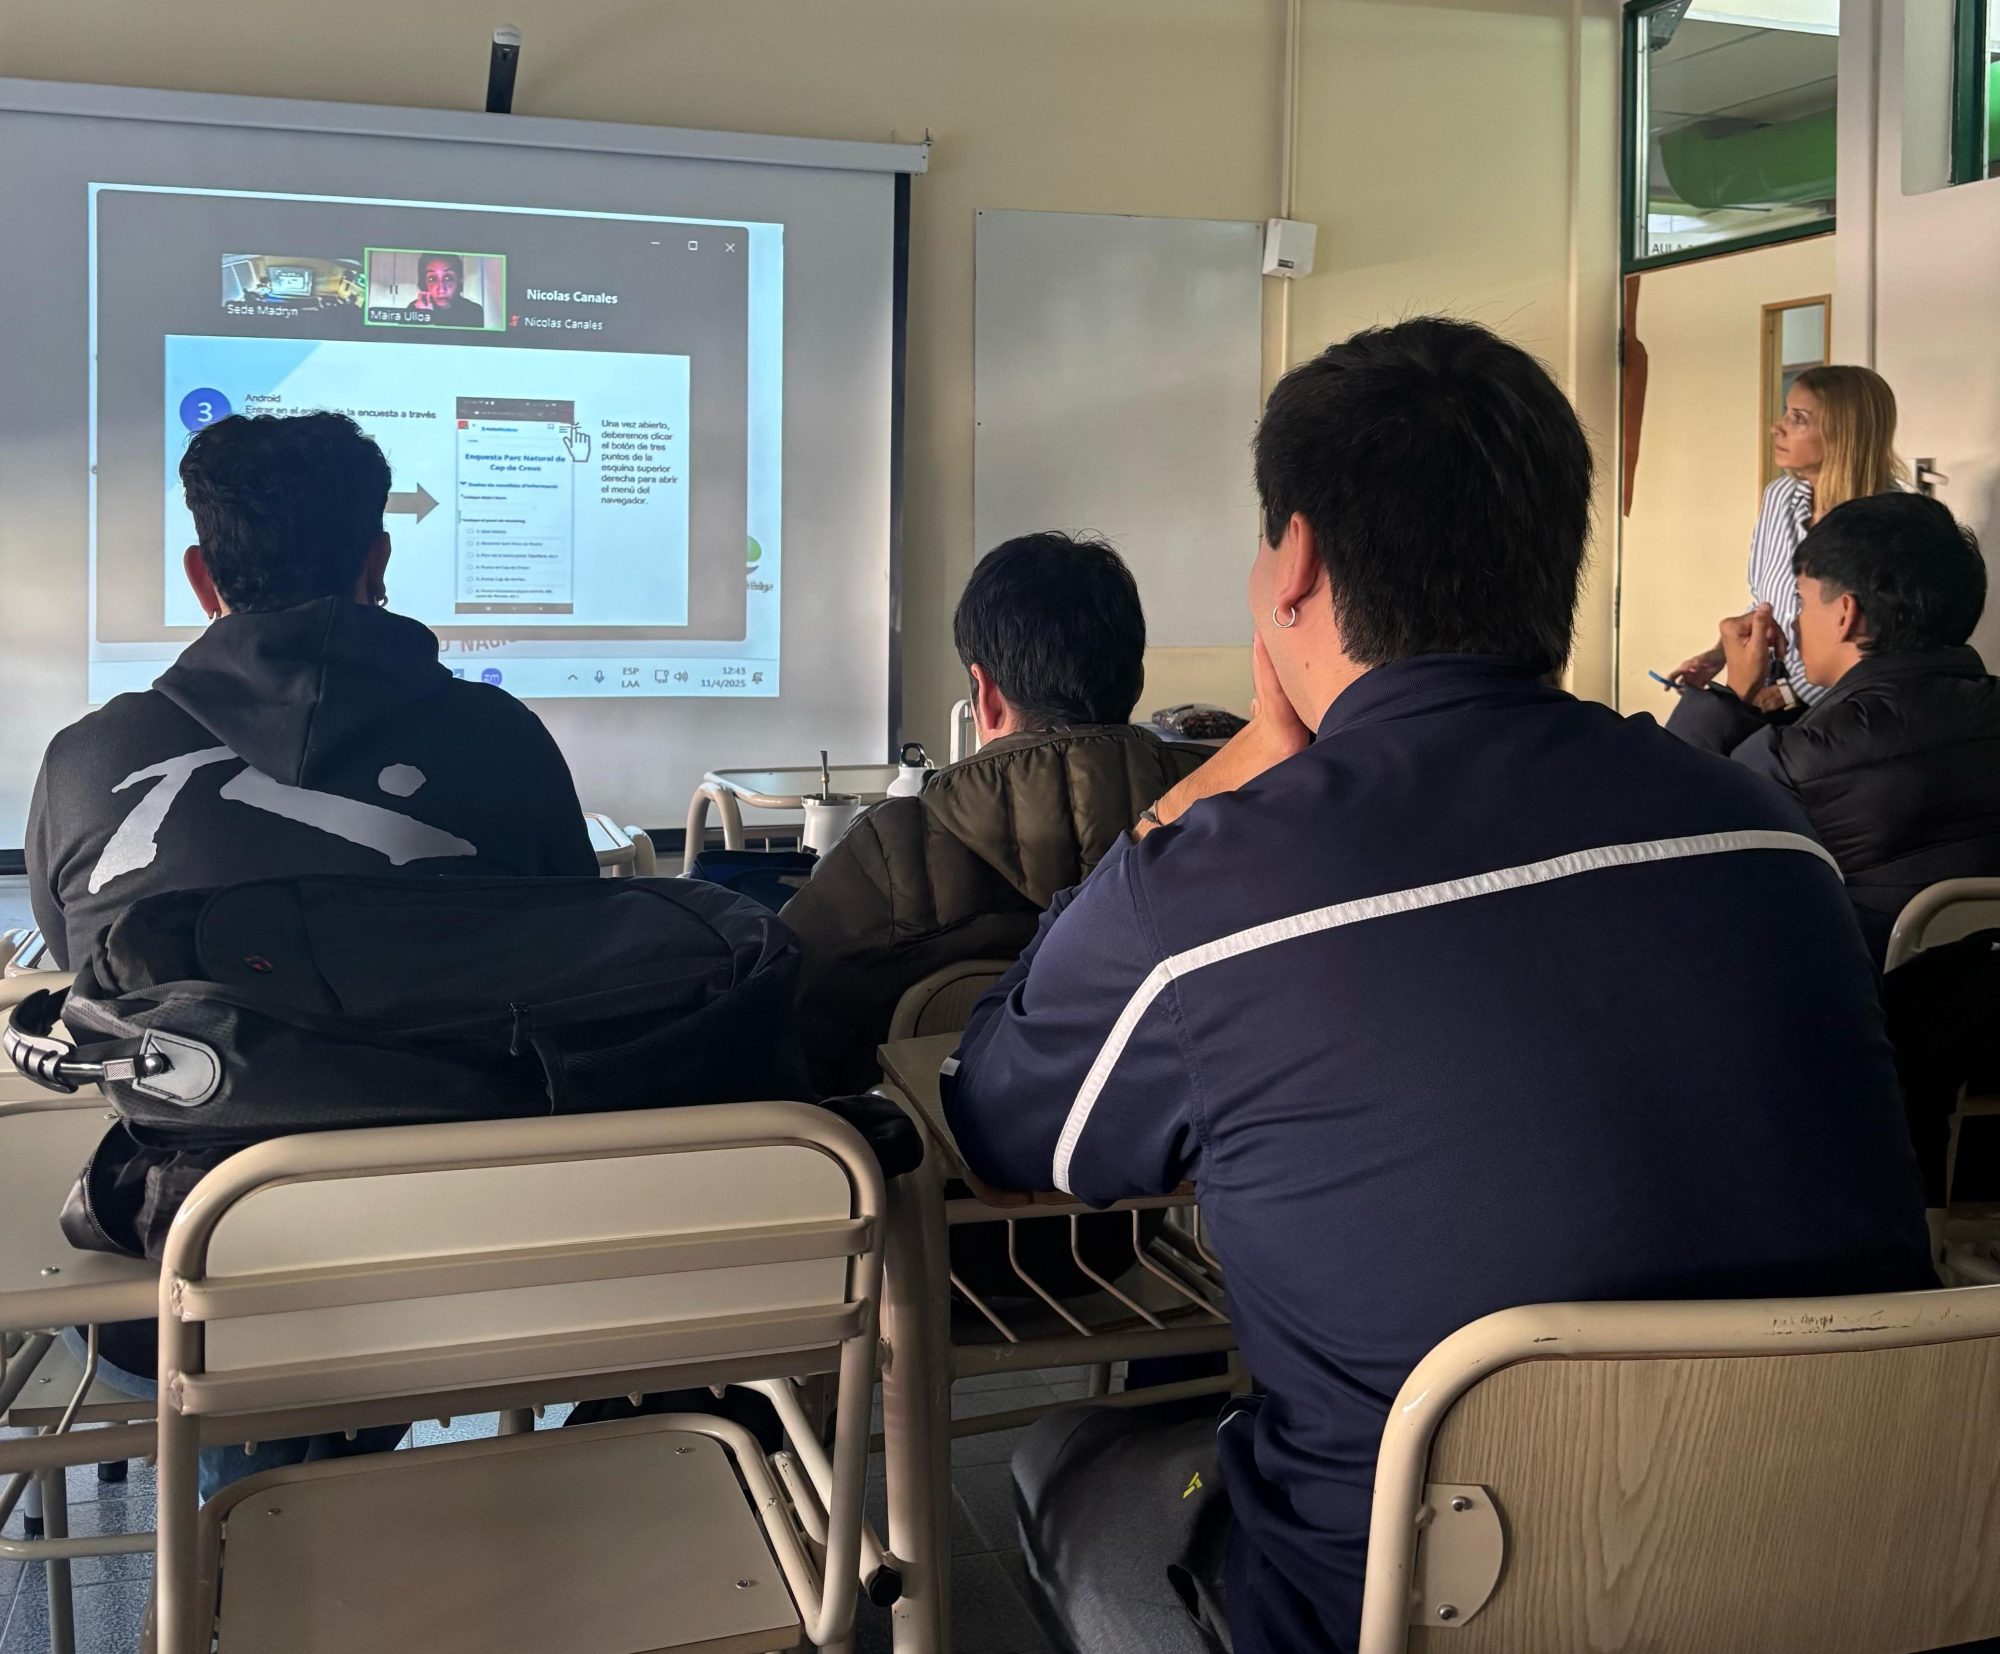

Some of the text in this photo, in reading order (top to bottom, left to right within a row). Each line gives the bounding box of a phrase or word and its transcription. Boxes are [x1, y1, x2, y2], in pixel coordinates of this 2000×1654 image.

[526, 288, 618, 305] Nicolas Canales
[227, 303, 298, 318] Sede Madryn
[370, 310, 431, 323] Maira Ulloa
[524, 317, 603, 331] Nicolas Canales
[245, 394, 281, 403] Android
[197, 402, 213, 423] 3
[245, 405, 274, 414] Entrar
[358, 409, 398, 418] encuesta
[409, 410, 437, 420] través
[601, 420, 619, 428] Una
[638, 421, 670, 431] abierto,
[601, 431, 673, 441] deberemos clicar
[601, 442, 666, 451] el botón de tres
[465, 454, 502, 463] Enquesta
[523, 455, 554, 463] Natural
[601, 453, 630, 462] puntos
[632, 453, 643, 461] de
[490, 464, 505, 472] Cap
[601, 464, 671, 474] esquina superior
[601, 474, 678, 485] derecha para abrir
[601, 486, 650, 495] el menú del
[601, 497, 649, 506] navegador.
[623, 668, 639, 676] ESP
[723, 667, 746, 676] 12:43
[621, 680, 640, 689] LAA
[701, 679, 746, 688] 11/4/2025
